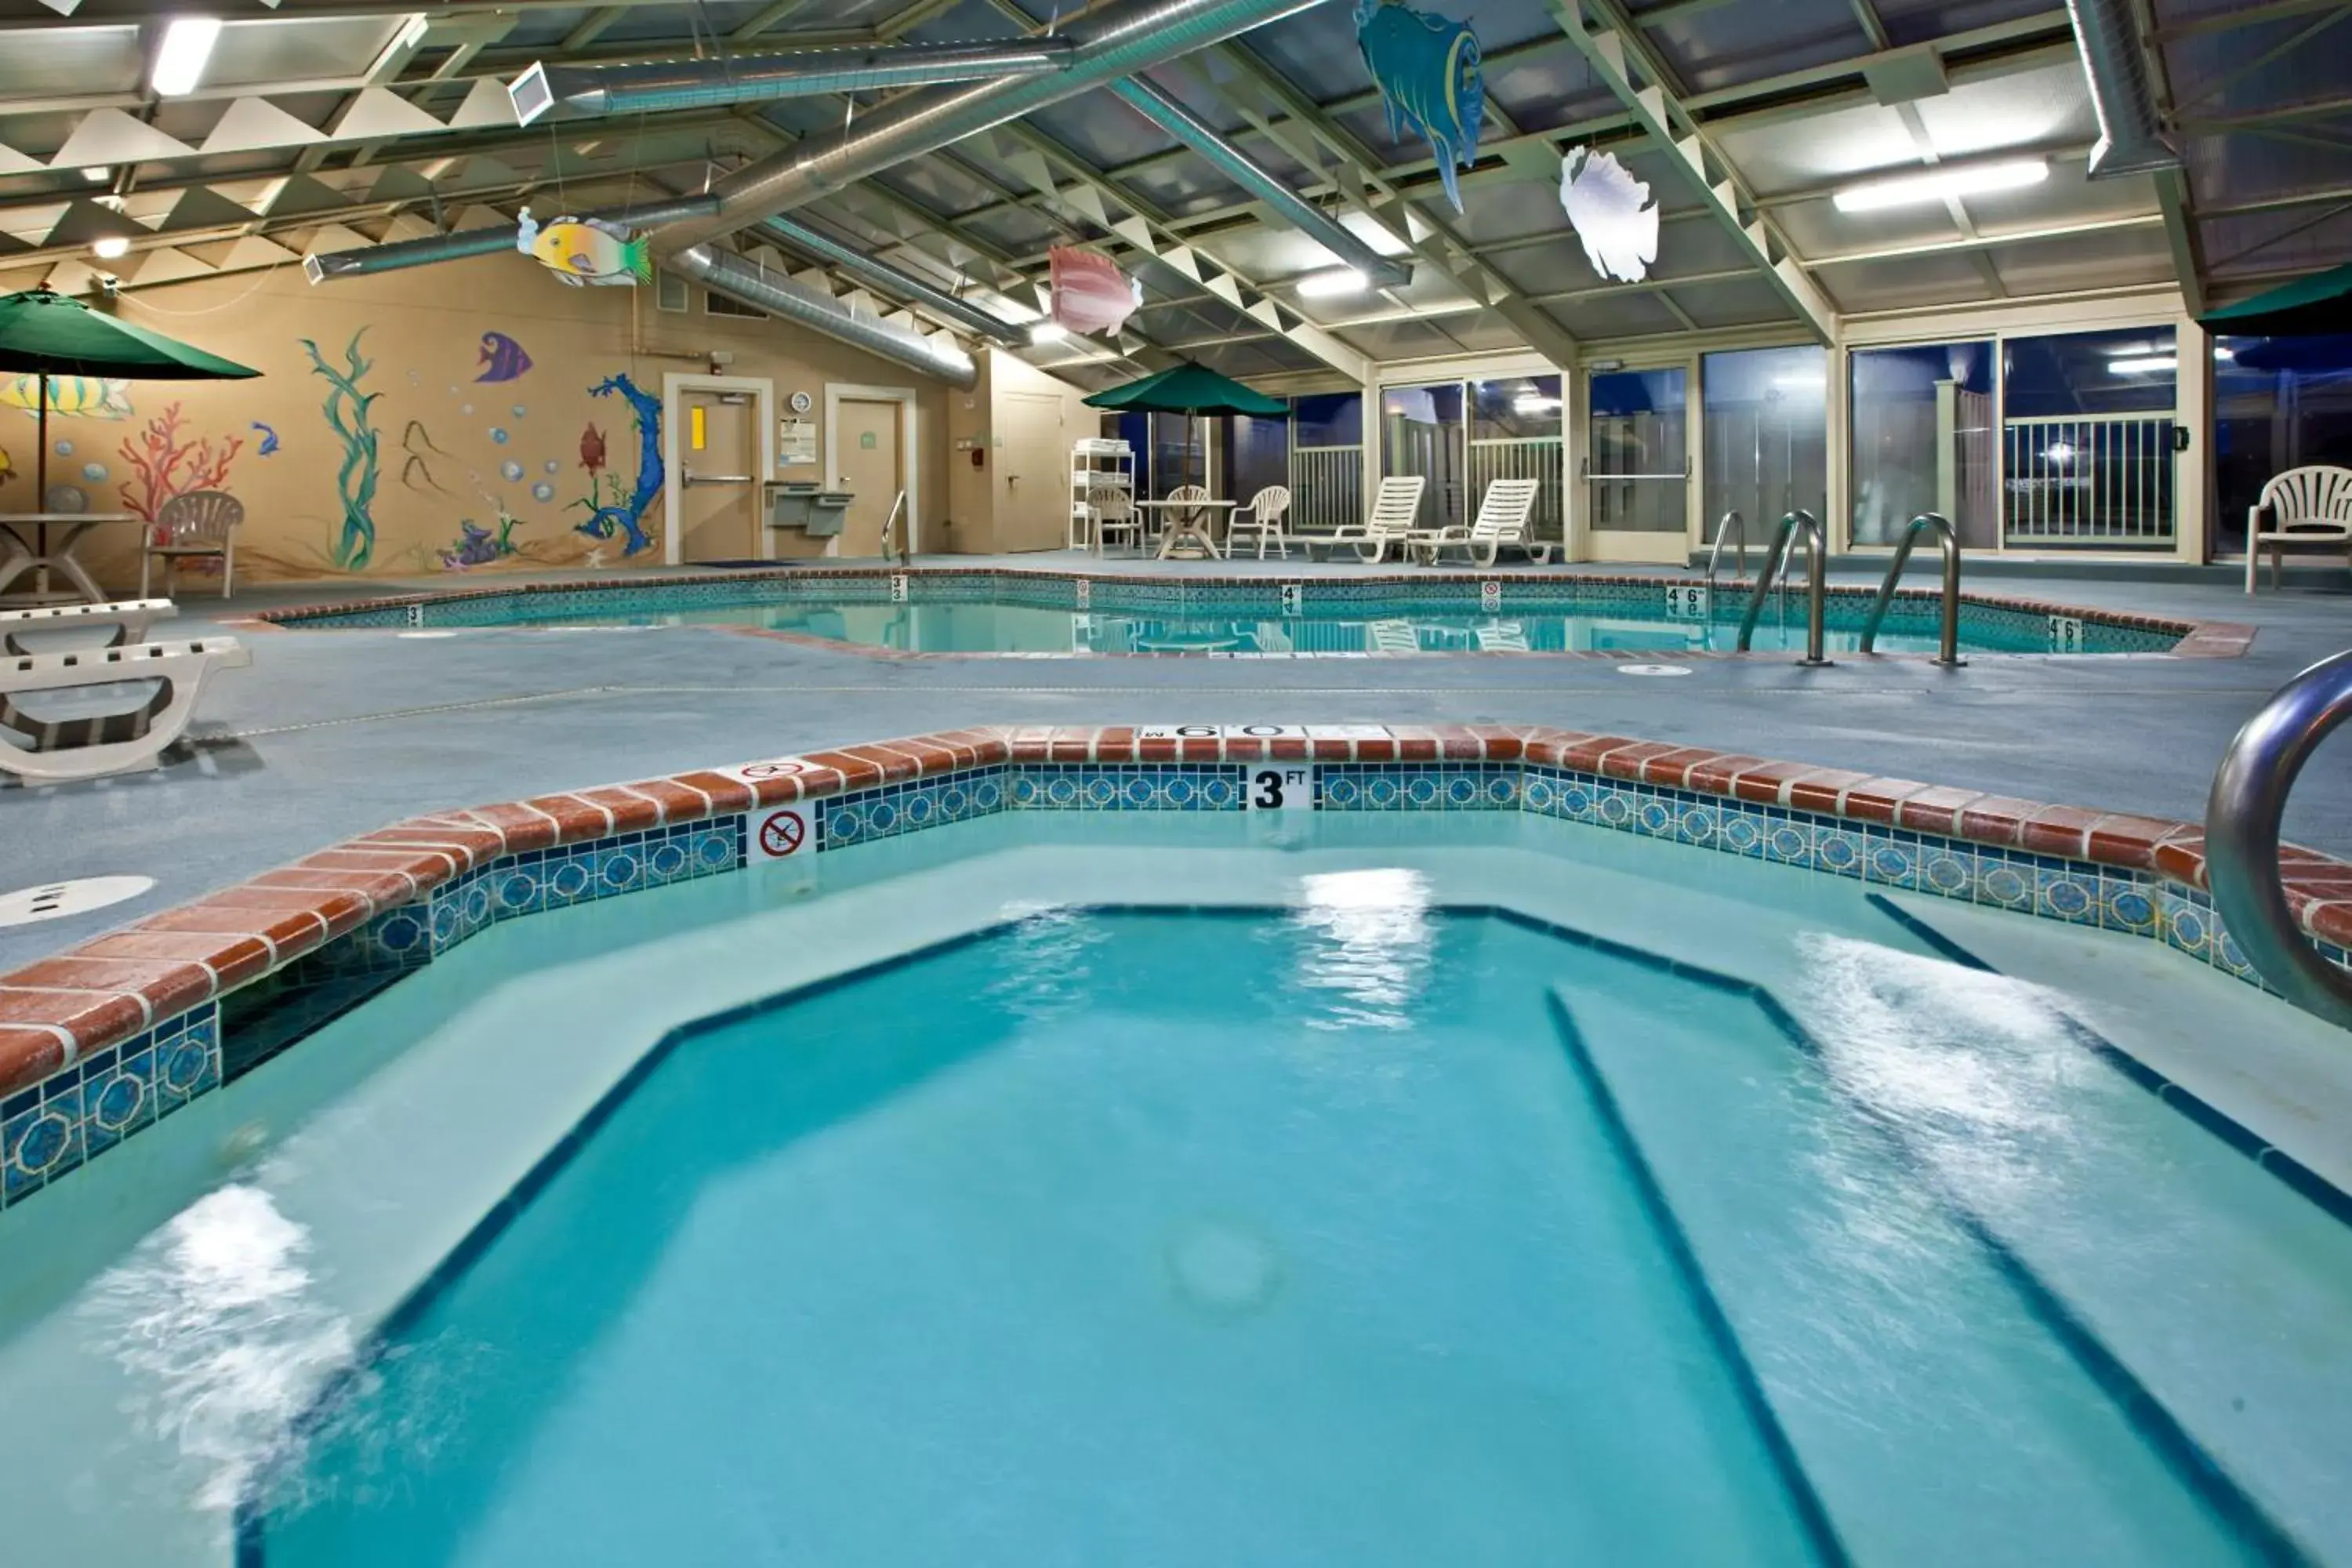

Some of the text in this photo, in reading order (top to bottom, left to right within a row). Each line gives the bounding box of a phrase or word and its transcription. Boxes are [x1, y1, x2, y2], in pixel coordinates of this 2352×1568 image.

[893, 576, 901, 587] 3
[1283, 586, 1293, 598] 4
[1668, 588, 1678, 601] 4
[1687, 589, 1697, 603] 6
[410, 606, 417, 620] 3
[2050, 618, 2074, 638] 4 6
[1255, 771, 1305, 809] 3 FT
